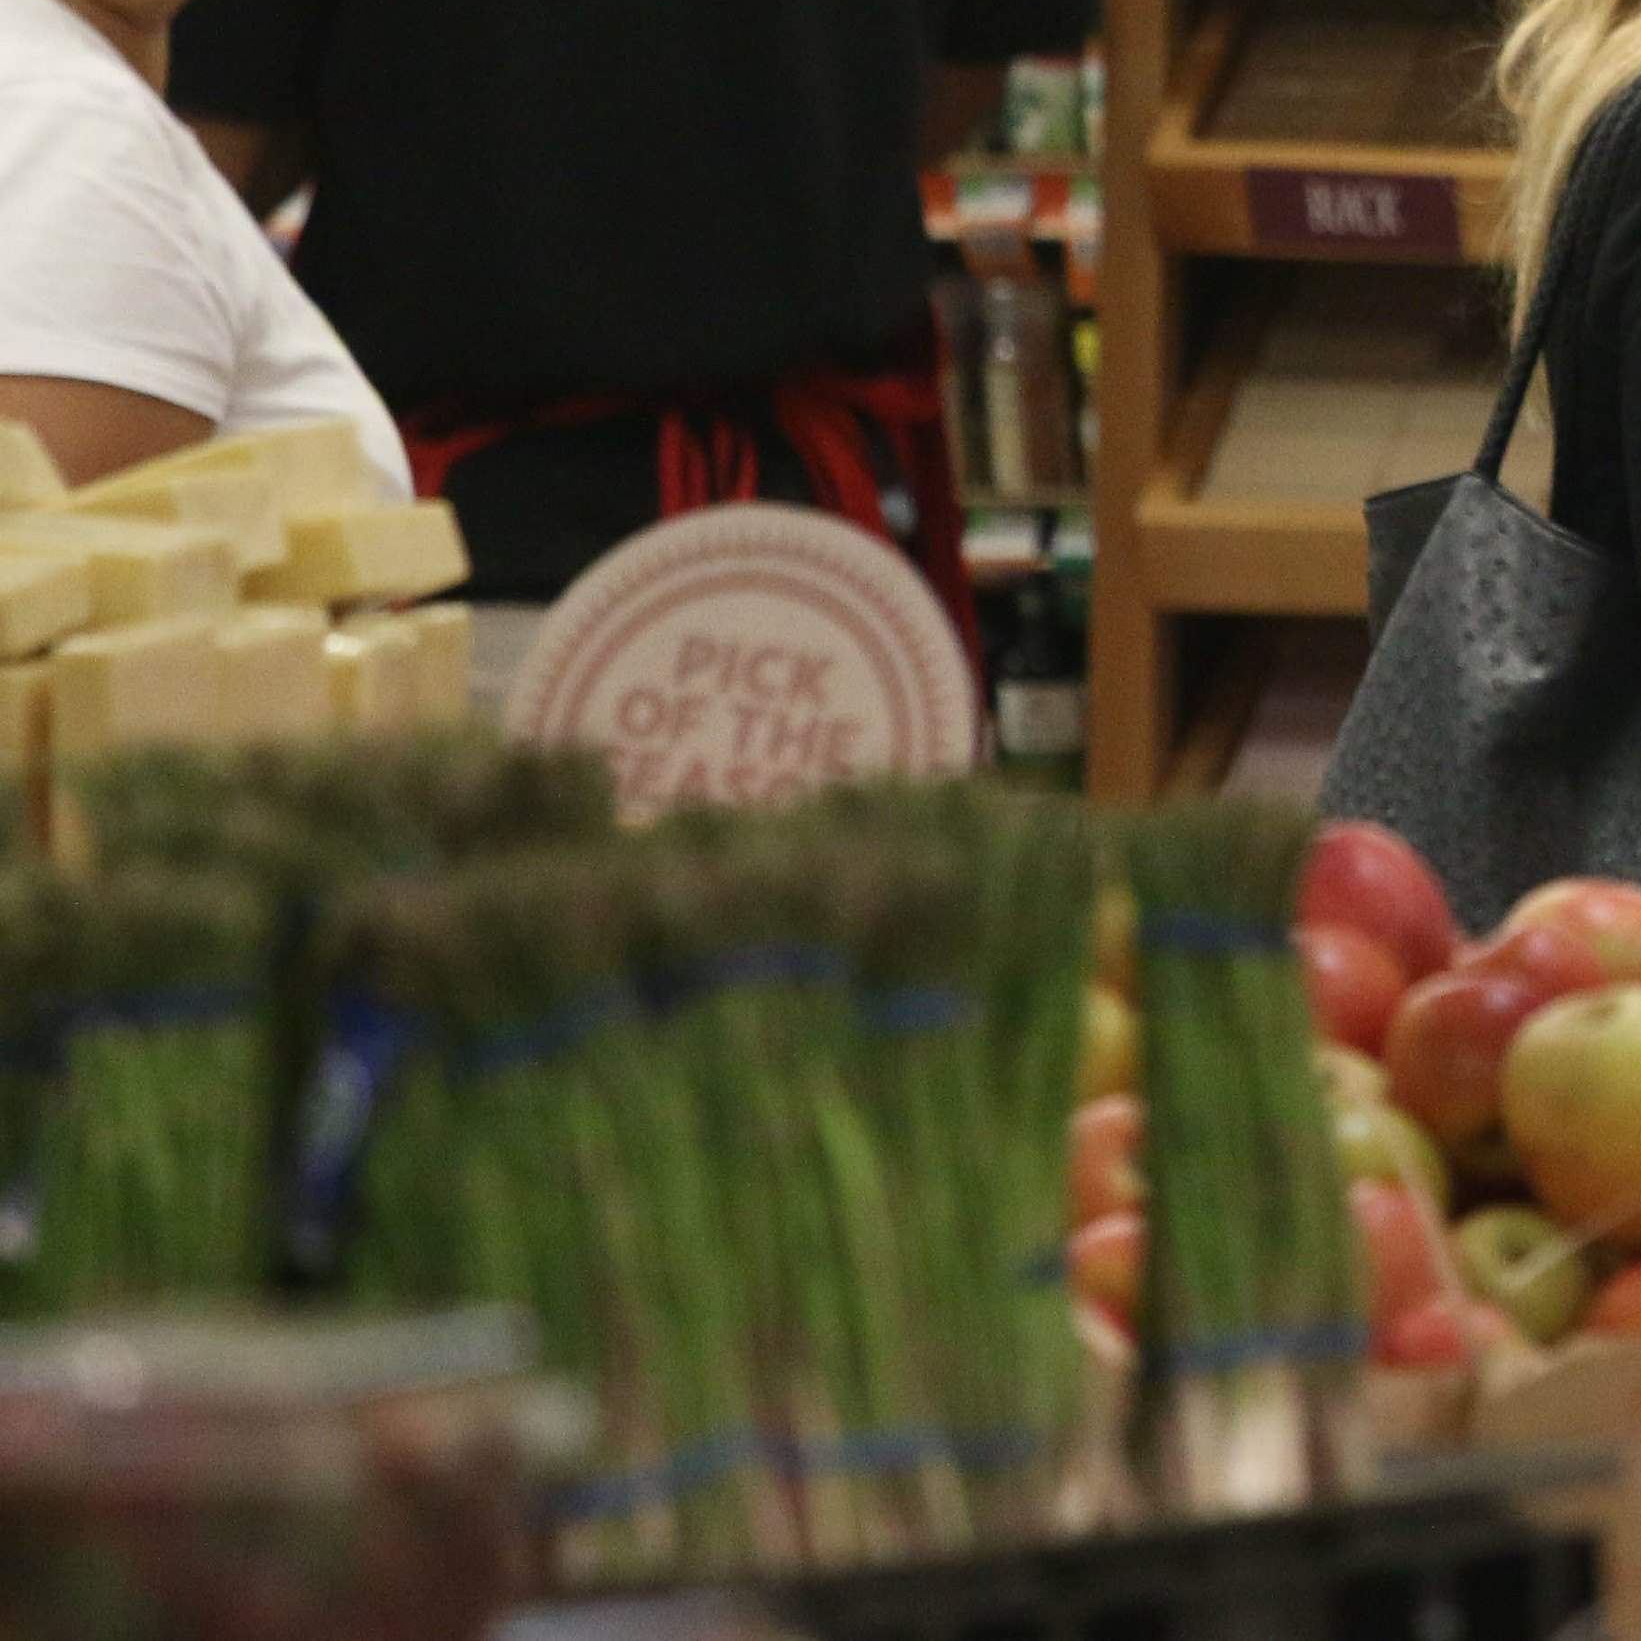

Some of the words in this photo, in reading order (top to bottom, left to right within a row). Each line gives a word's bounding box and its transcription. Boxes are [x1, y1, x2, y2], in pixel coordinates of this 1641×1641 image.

[673, 635, 834, 700] PICK
[615, 686, 707, 736] OF
[732, 703, 863, 778] THE
